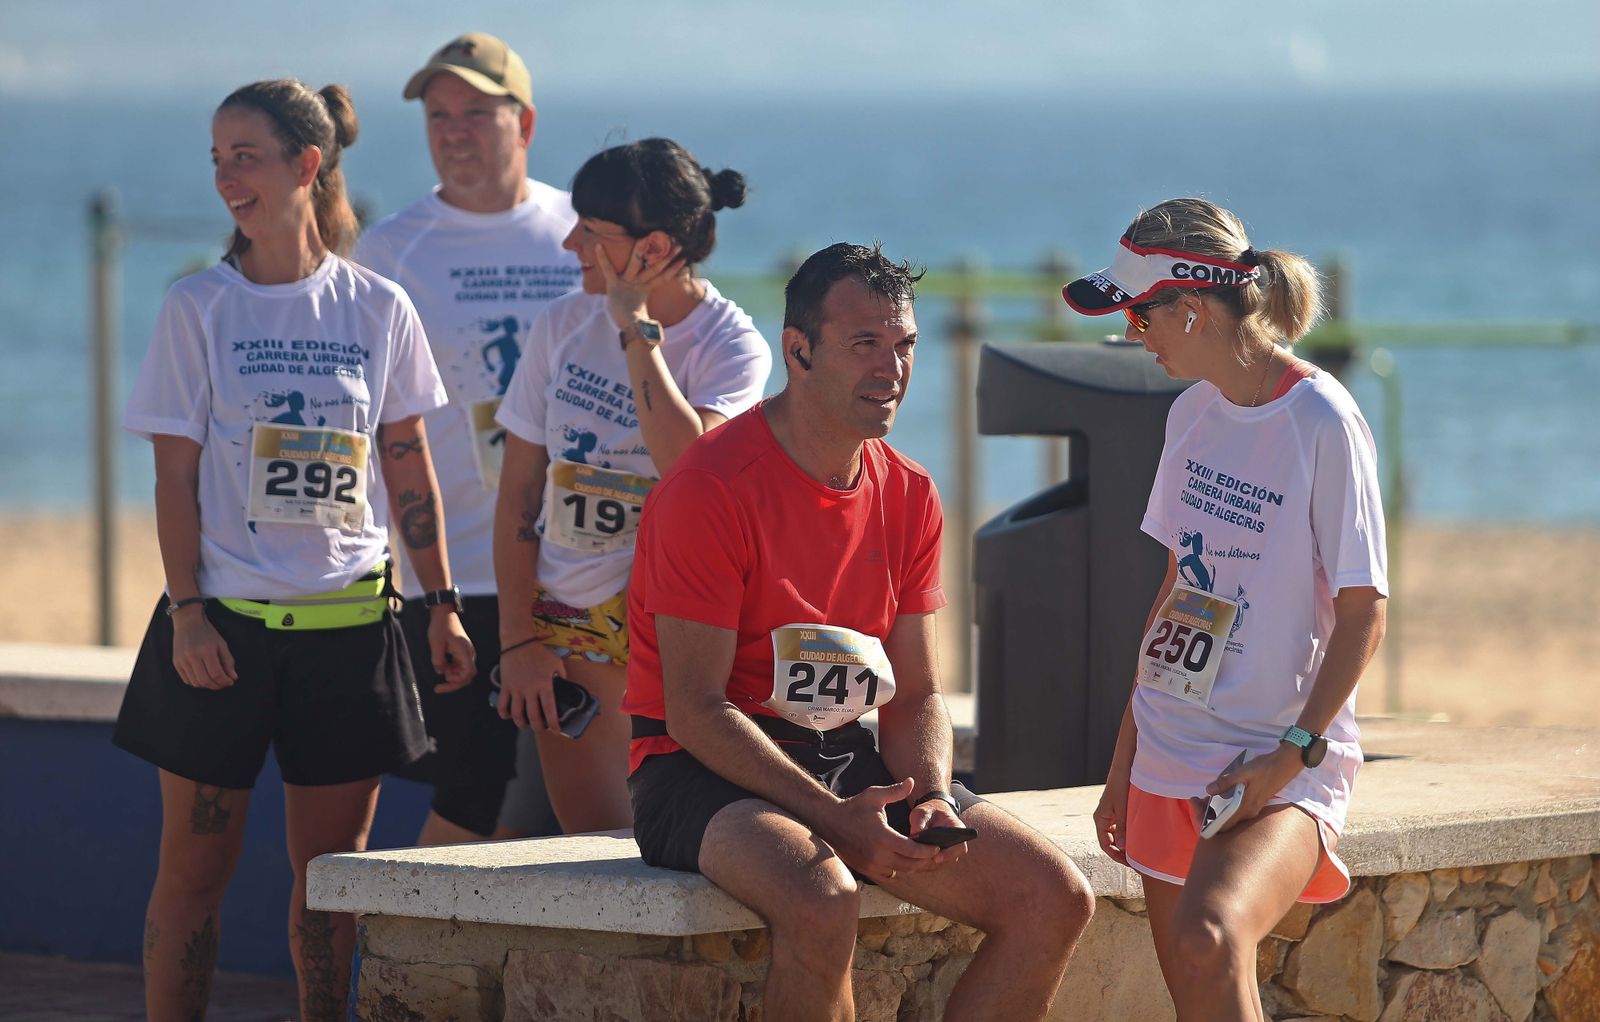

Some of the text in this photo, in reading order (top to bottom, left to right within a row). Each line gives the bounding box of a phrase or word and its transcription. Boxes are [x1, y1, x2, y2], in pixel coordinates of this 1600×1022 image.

[232, 339, 369, 359] XXIII EDICIÓN
[246, 351, 363, 366] CARRERA URBANA
[239, 364, 285, 376] CIUDAD
[288, 364, 304, 374] DE
[566, 362, 608, 387] XXIII
[556, 388, 594, 411] CIUDAD
[596, 405, 614, 420] DE
[567, 379, 623, 410] CARRERA
[280, 449, 309, 458] CIUDAD
[265, 459, 357, 504] 292
[1185, 459, 1283, 506] XXIII EDICIÓN
[1188, 476, 1262, 515] CARRERA URBANA
[1180, 490, 1265, 533] CIUDAD DE ALGECIRAS
[1214, 547, 1226, 558] nos
[800, 630, 817, 640] XXIII
[1146, 620, 1214, 673] 250
[800, 650, 825, 661] CIUDAD
[826, 652, 836, 662] DE
[786, 662, 879, 706] 241
